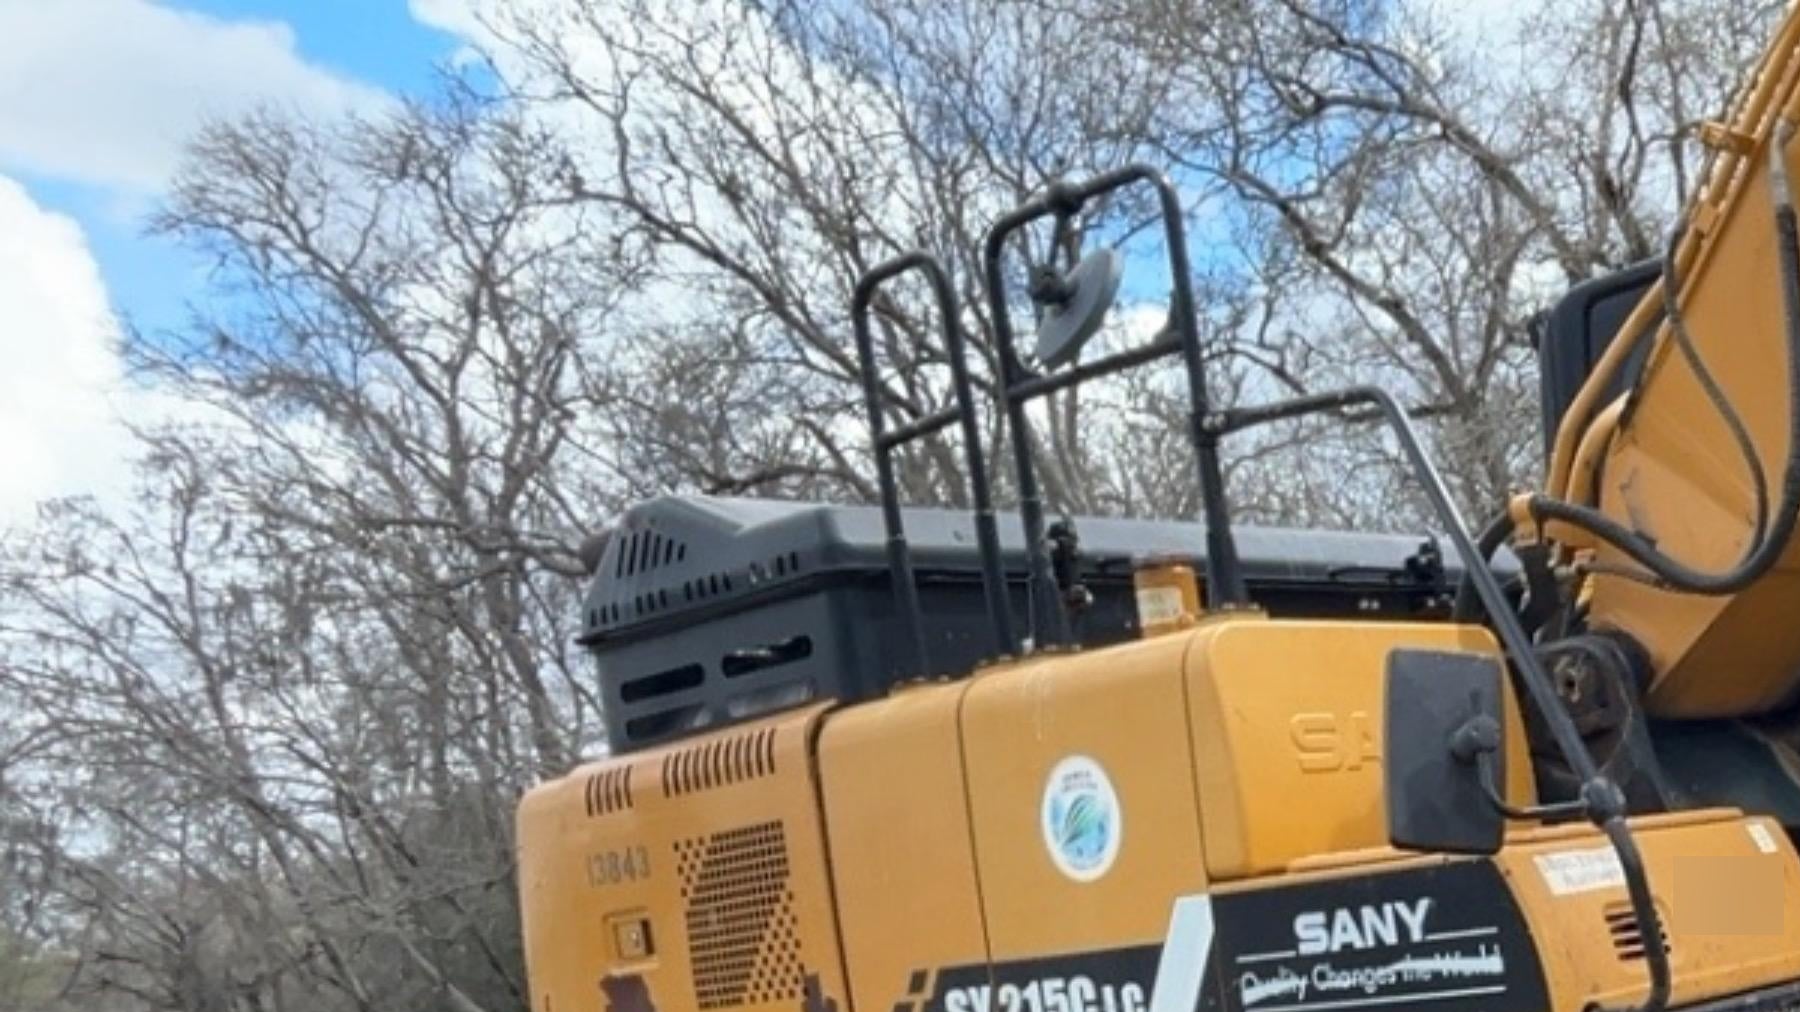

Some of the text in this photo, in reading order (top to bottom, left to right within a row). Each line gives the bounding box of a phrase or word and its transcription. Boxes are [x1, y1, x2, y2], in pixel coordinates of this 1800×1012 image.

[1288, 711, 1383, 775] SA
[1294, 897, 1432, 956] SANY
[1311, 963, 1396, 994] Changes
